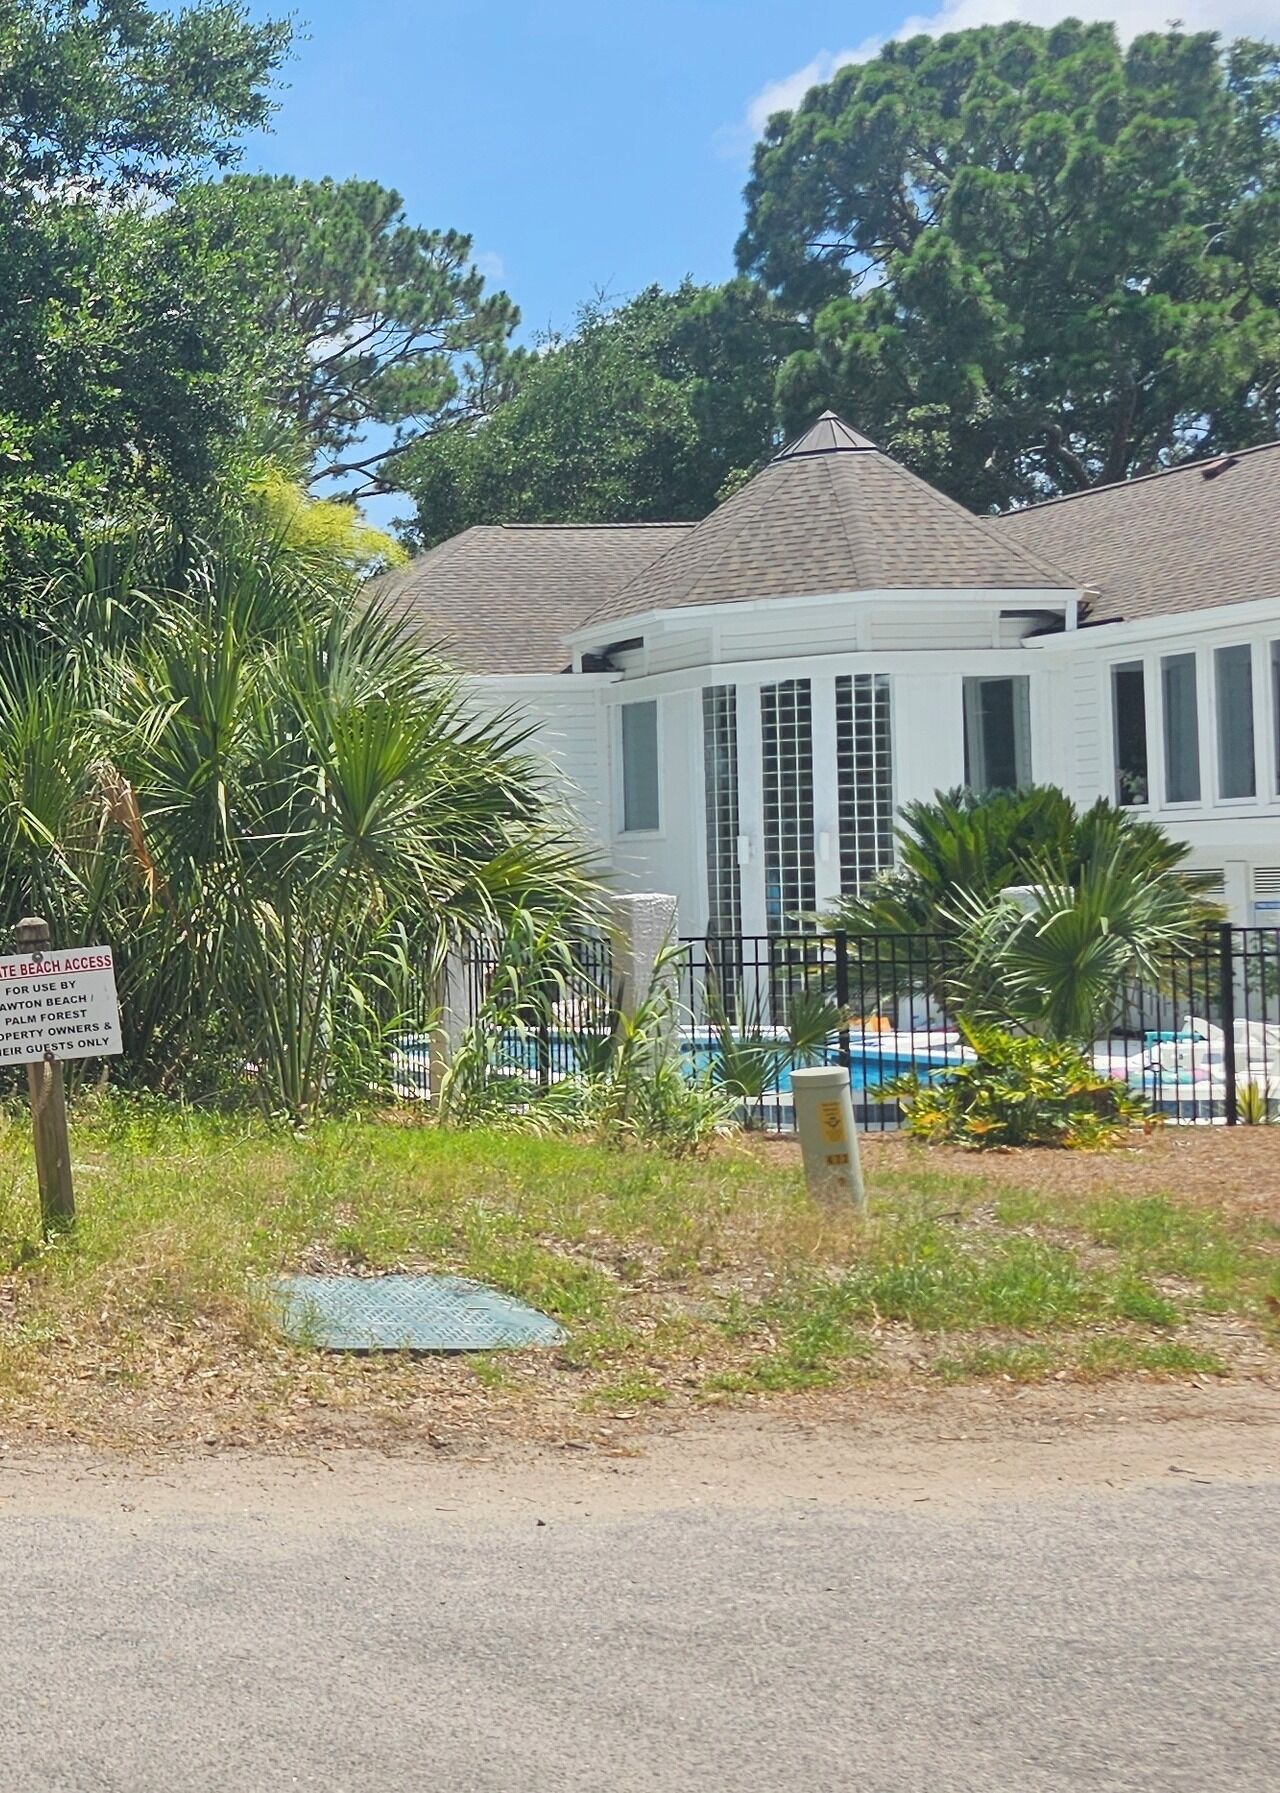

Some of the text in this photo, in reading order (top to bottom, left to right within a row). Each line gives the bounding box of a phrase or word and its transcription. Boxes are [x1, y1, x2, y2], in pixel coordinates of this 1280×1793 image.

[20, 959, 61, 976] BEACH
[65, 954, 112, 971] ACCESS
[5, 980, 77, 996] FOR USE BY
[46, 994, 87, 1007] BEACH
[5, 1009, 88, 1026] PALM FOREST
[48, 1023, 100, 1036] OWNERS
[103, 1021, 112, 1030] &
[26, 1040, 74, 1054] GUESTS
[77, 1037, 111, 1048] ONLY
